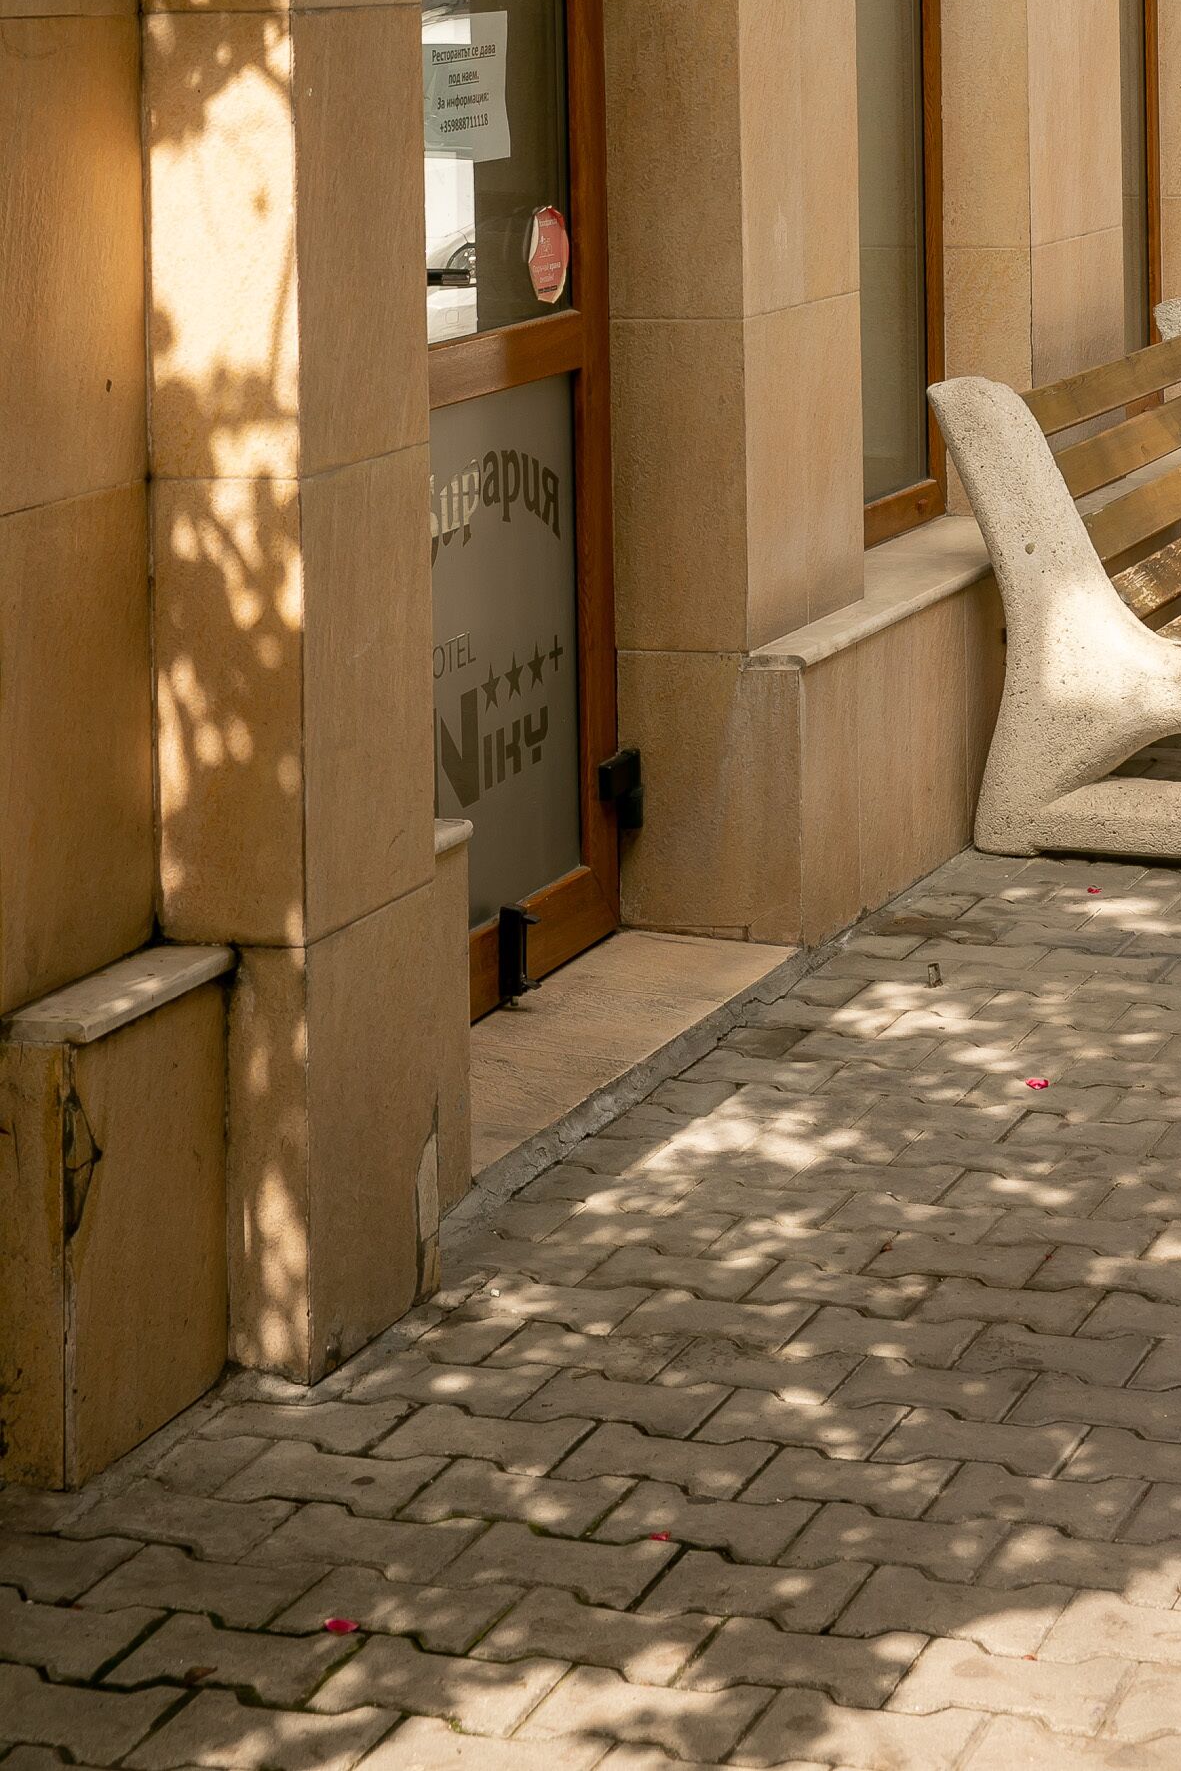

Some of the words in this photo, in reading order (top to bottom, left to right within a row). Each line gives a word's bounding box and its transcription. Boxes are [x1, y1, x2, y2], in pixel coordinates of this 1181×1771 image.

[432, 47, 471, 63] Ресторантът
[472, 46, 479, 57] се
[480, 44, 496, 57] дава
[448, 73, 460, 84] под
[461, 70, 480, 82] наем.
[437, 97, 445, 110] За
[446, 92, 490, 110] информация:
[440, 113, 489, 133] +359888711118
